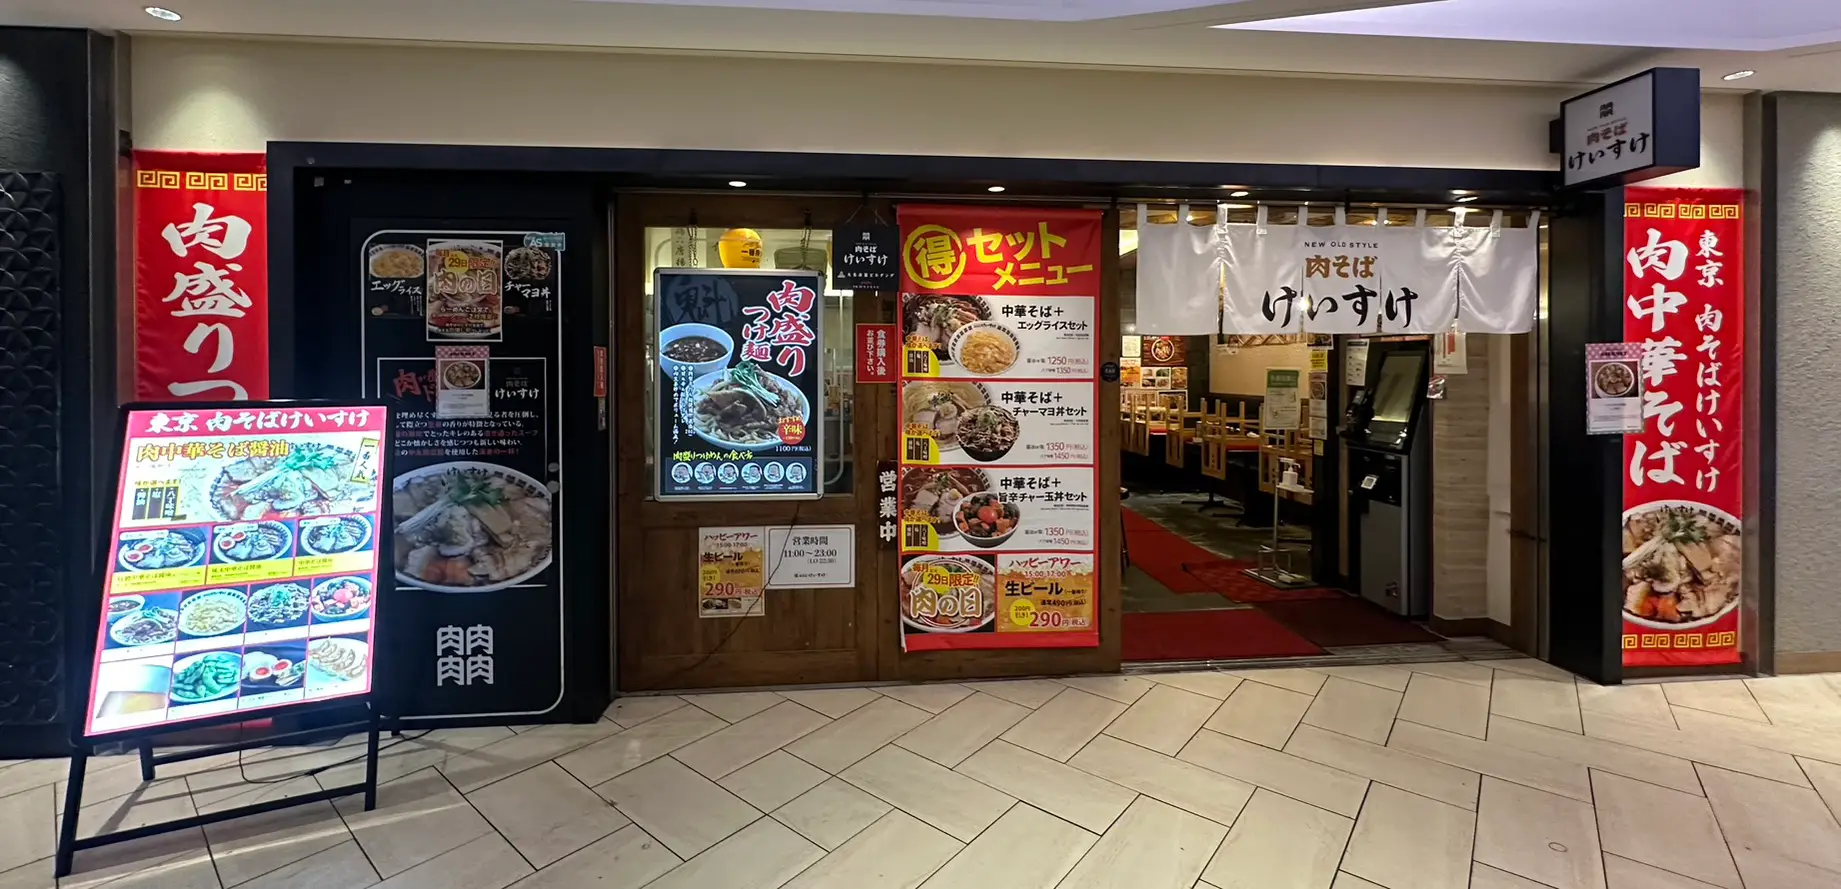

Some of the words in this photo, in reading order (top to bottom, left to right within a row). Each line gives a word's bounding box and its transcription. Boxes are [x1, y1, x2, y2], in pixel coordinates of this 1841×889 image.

[1587, 122, 1628, 146] 肉そば
[1568, 132, 1650, 170] けいすけ
[855, 245, 878, 253] 肉そば
[965, 221, 1067, 264] セット
[844, 253, 888, 266] けいすけ
[913, 234, 956, 279] 得
[1695, 229, 1724, 288] 東京
[1305, 254, 1378, 279] 肉そば
[433, 268, 498, 295] 肉の日
[992, 262, 1094, 291] メニュー
[370, 279, 405, 293] エッグ
[398, 286, 423, 295] ライス
[504, 281, 531, 291] チャー
[521, 286, 551, 298] マヨ丼
[1001, 304, 1064, 318] 中華そば+
[1261, 284, 1419, 328] けいすけ
[766, 278, 816, 377] 肉盛り
[1017, 320, 1088, 331] エッグライスセット
[740, 306, 771, 362] つけ麺
[1626, 228, 1689, 487] 肉中華そば
[494, 387, 540, 400] けいすけ
[1001, 391, 1063, 405] 中華そば+
[1694, 303, 1724, 493] 肉そばけいすけ
[1012, 406, 1087, 417] チャーマヨ丼セット
[145, 412, 199, 434] 東京
[205, 410, 371, 432] 肉そばけいすけ
[136, 439, 290, 461] 肉中華そば醤油
[673, 449, 753, 461] 肉盛りつけめんの食べ方
[1000, 476, 1062, 490] 中華そば+
[998, 491, 1088, 503] 旨辛チャー玉丼セット
[879, 469, 898, 542] 営業中
[704, 532, 758, 541] ハッピーアワー
[792, 535, 829, 546] 営業時間
[703, 551, 743, 562] 生ビール
[1009, 557, 1081, 568] ハッピーアワー
[1005, 581, 1064, 597] 生ビール
[910, 585, 982, 618] 肉の日
